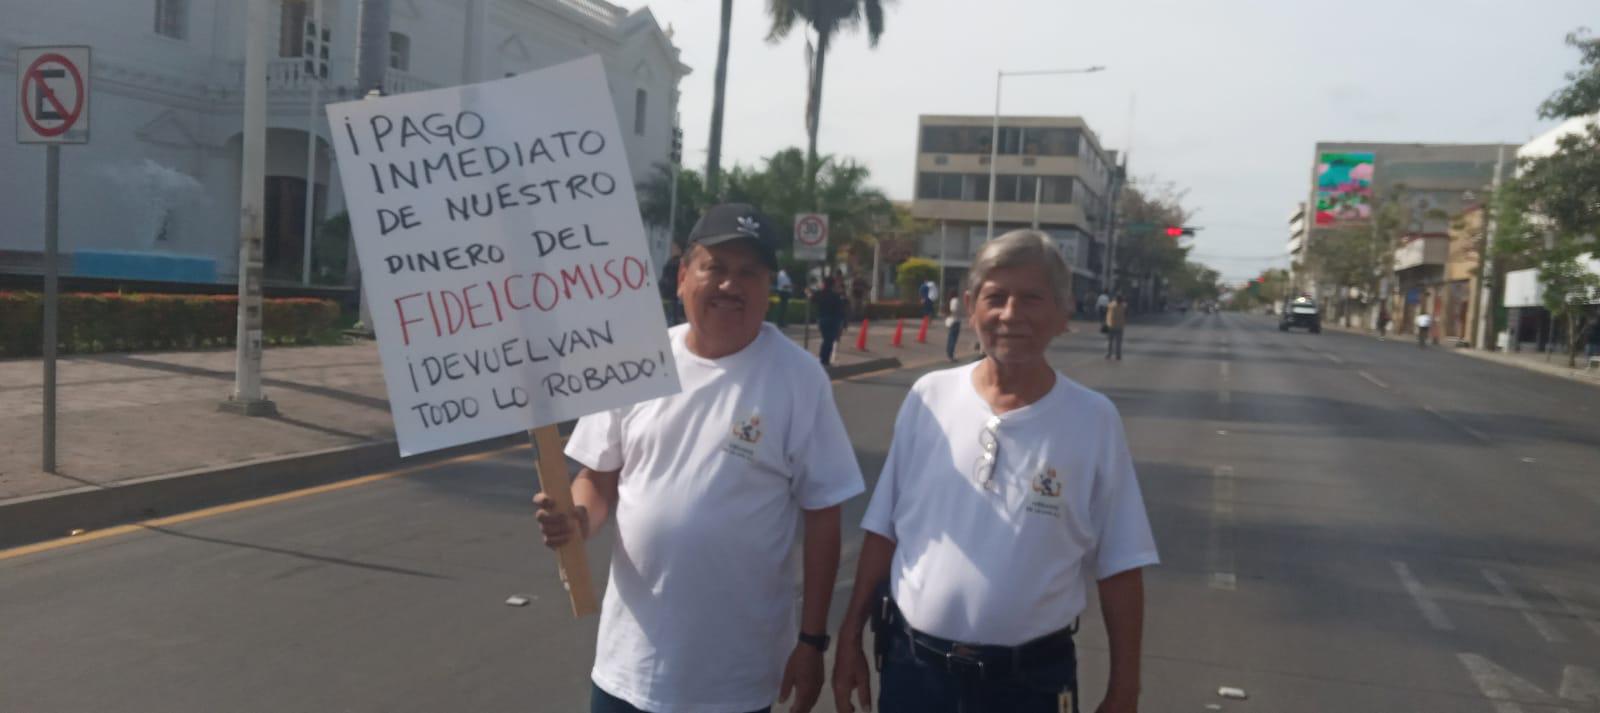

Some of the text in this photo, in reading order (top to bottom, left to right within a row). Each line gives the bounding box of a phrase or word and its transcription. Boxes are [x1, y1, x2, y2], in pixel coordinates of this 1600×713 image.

[369, 129, 605, 194] INMEDIATO
[376, 171, 616, 236] DE NUESTRO
[384, 224, 609, 275] DINERO DEL
[394, 255, 651, 346] FIDEICOMISO!
[411, 351, 669, 429] TODO LO ROBADO!
